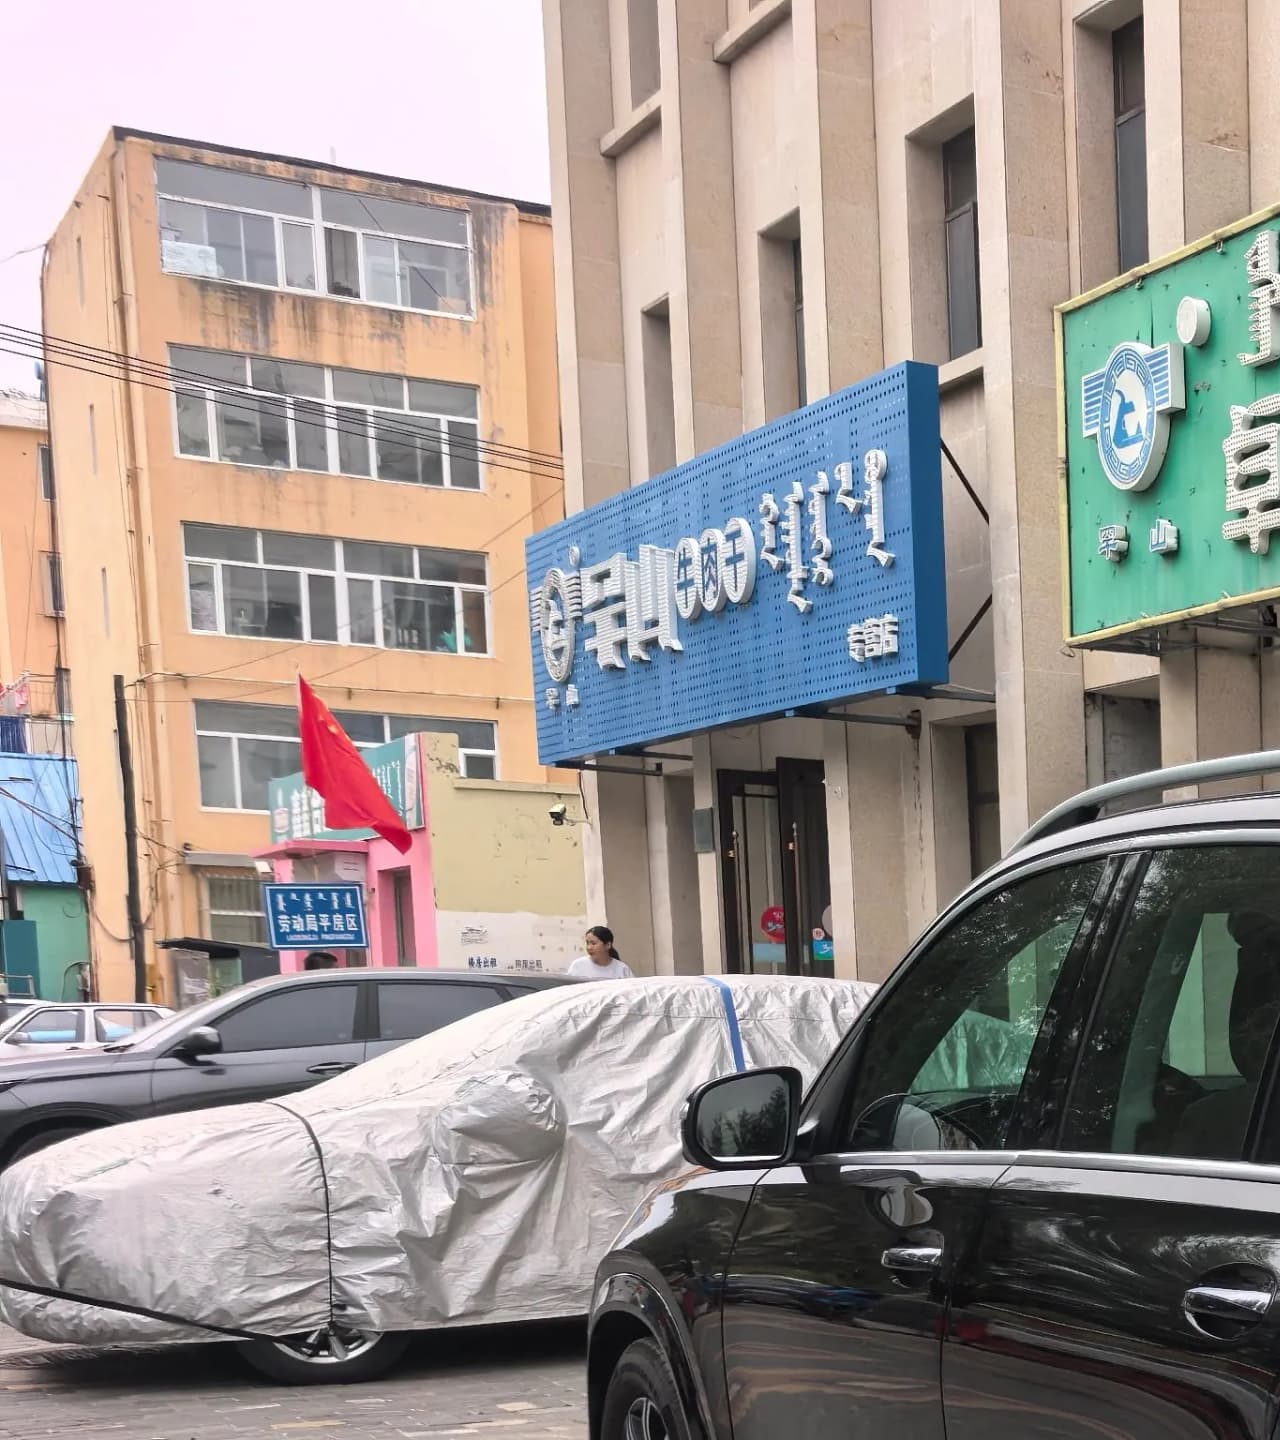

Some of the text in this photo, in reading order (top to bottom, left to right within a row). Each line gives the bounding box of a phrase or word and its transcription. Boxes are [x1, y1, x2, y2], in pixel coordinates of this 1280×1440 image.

[1098, 519, 1177, 564] 罕山
[277, 913, 360, 933] 劳动局平房区
